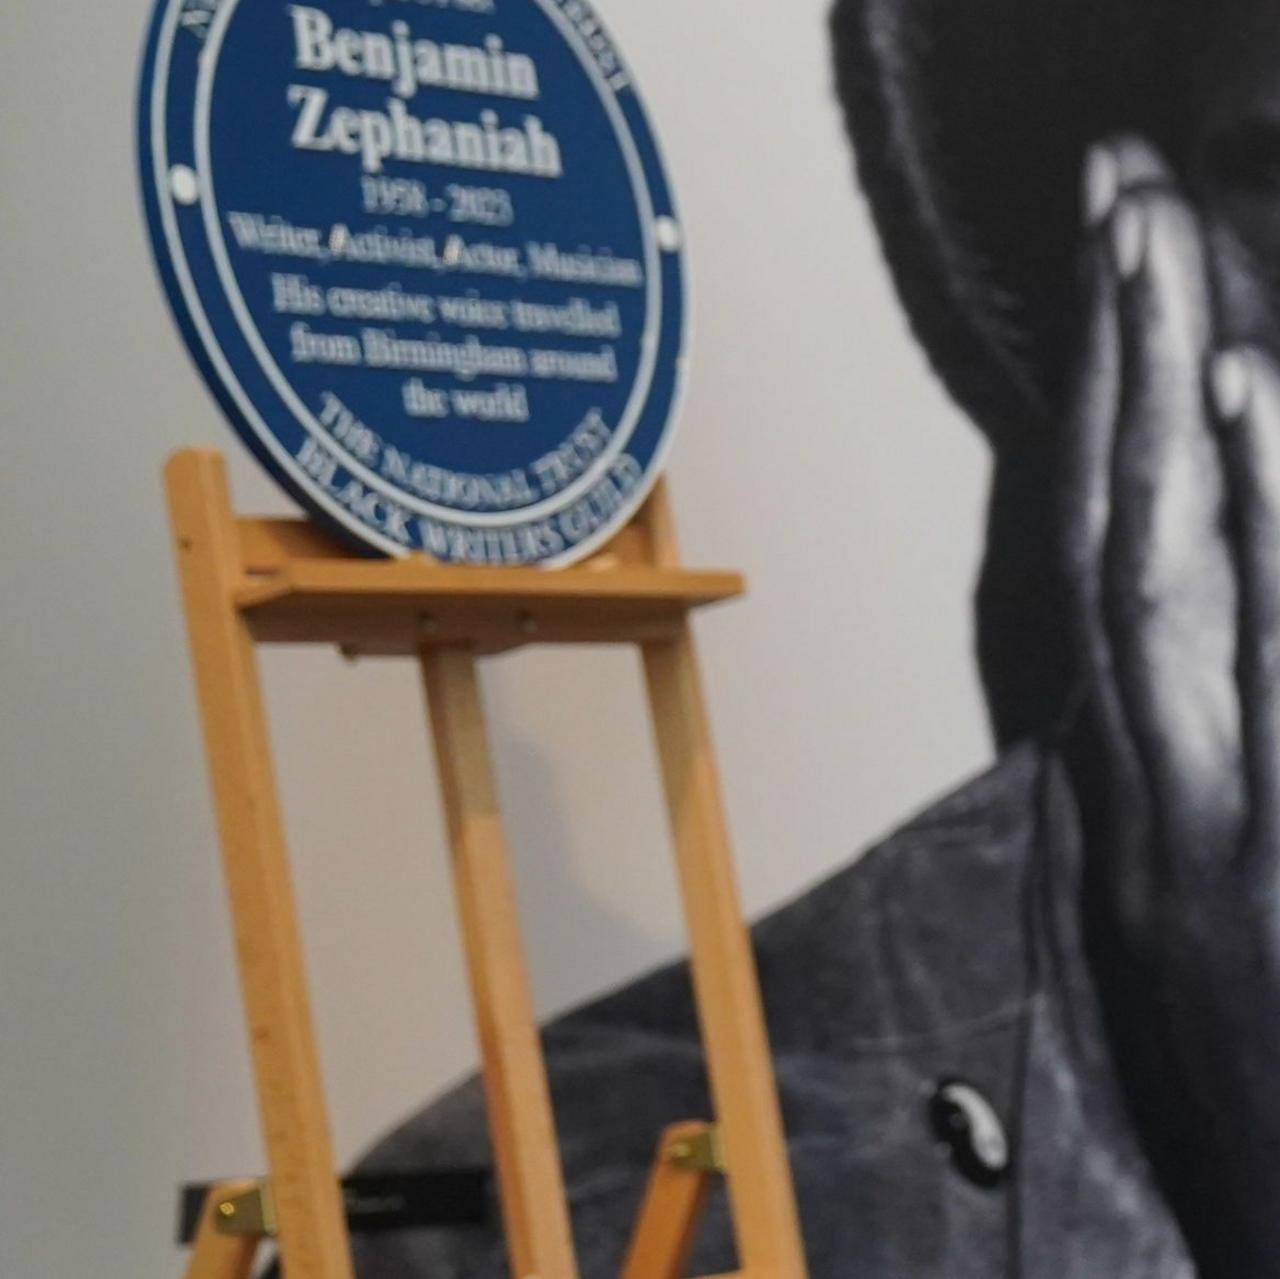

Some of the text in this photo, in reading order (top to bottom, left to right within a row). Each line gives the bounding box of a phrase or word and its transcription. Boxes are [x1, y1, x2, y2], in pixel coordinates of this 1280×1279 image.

[288, 4, 540, 100] Benjamin
[286, 83, 564, 178] Zephaniah
[361, 175, 430, 218] 1958
[445, 182, 514, 227] 2023
[525, 240, 643, 288] Musician
[271, 271, 622, 339] His creative voice travelled
[290, 321, 618, 383] from Birmingham around
[402, 376, 529, 421] the world
[319, 390, 613, 511] THE NATIONAL TRUST
[297, 436, 413, 545] BLACK
[558, 452, 643, 545] GUILD
